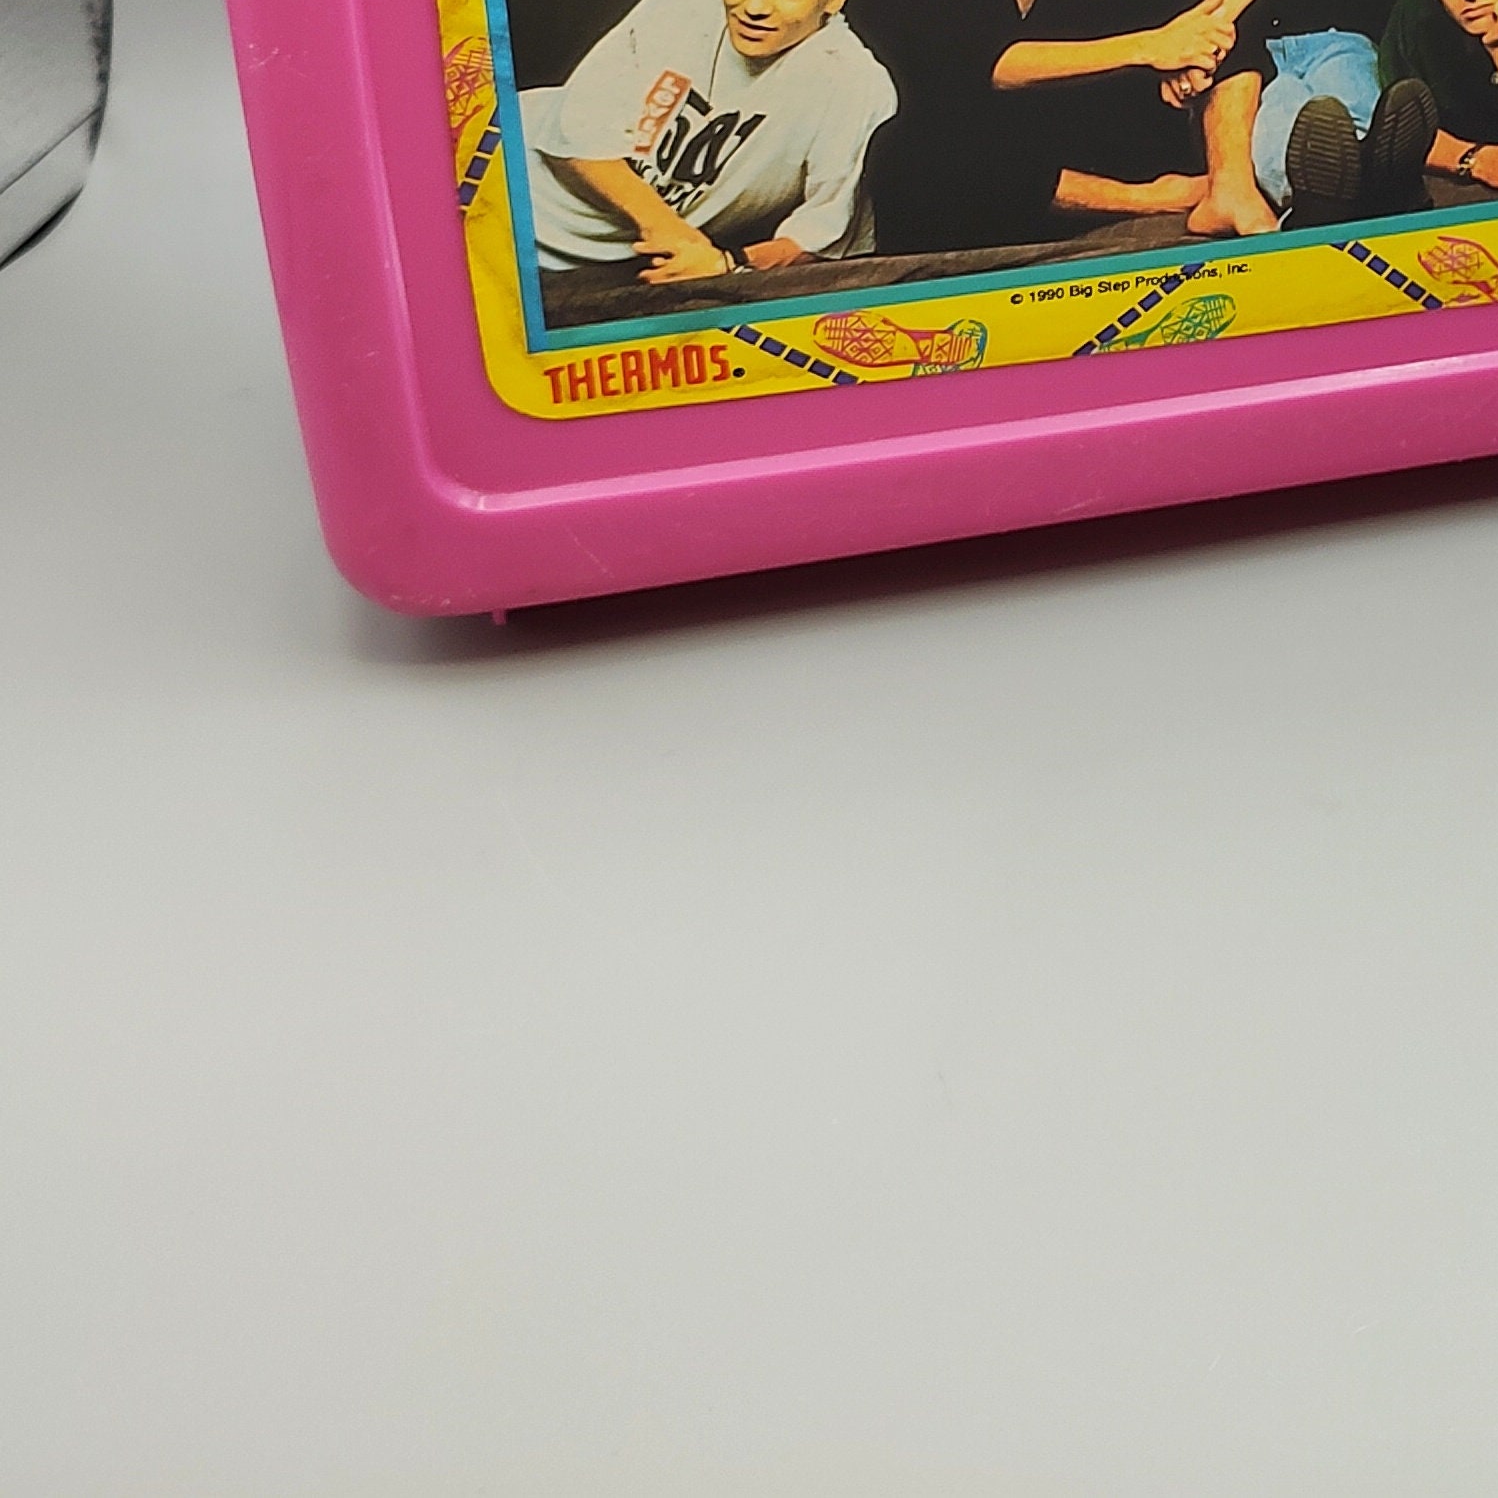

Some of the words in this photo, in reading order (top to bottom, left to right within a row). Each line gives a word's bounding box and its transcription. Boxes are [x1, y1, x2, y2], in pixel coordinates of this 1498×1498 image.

[1029, 287, 1065, 303] 1990
[1069, 284, 1093, 299] Big
[1097, 280, 1131, 294] Step
[1135, 267, 1223, 289] Prodons,
[1227, 263, 1252, 275] Inc.
